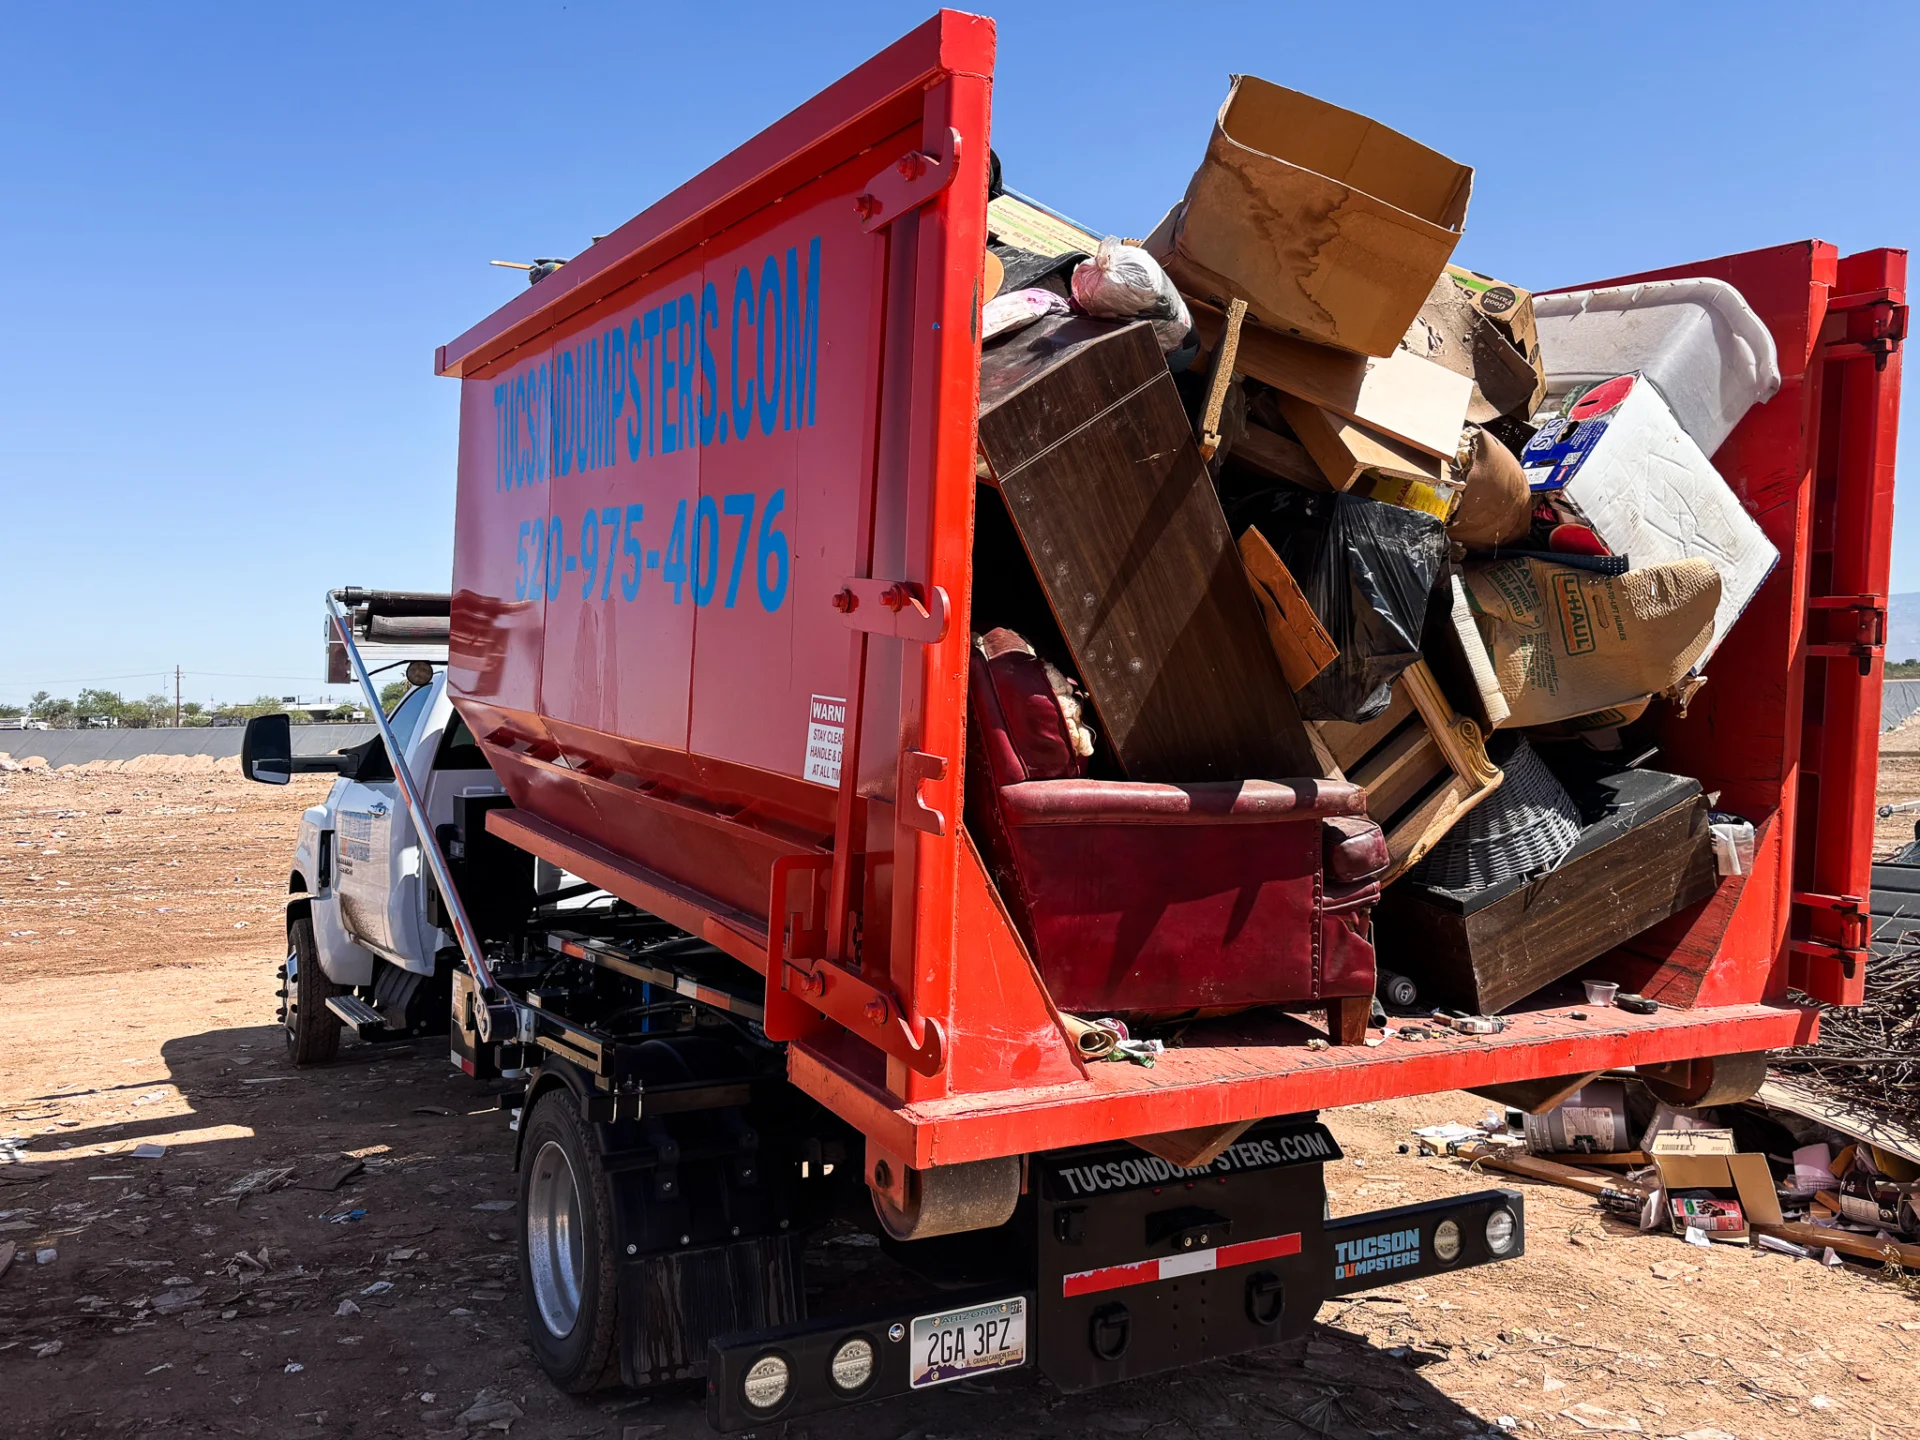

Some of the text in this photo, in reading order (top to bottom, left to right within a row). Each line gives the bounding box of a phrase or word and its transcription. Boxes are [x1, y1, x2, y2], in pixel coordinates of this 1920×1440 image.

[1483, 297, 1506, 310] Good
[1485, 291, 1514, 306] Farms
[494, 236, 822, 493] TUCSONDUMPSTERS.COM
[515, 488, 790, 613] 520-975-4076
[1487, 570, 1525, 617] GUARANTEED
[1497, 565, 1534, 613] BEST PRICE
[1563, 578, 1591, 650] U-HAUL
[1604, 577, 1628, 641] ASY-TO-LIFT HANDLES
[813, 702, 846, 723] WARNI
[813, 728, 827, 742] STAY
[810, 745, 832, 762] HANDLE
[832, 749, 837, 762] &
[812, 763, 820, 776] AT
[819, 764, 830, 779] ALL
[1058, 1132, 1332, 1194] TUCSONDUSTERS.COM
[1335, 1227, 1420, 1264] TUCSON
[1335, 1250, 1420, 1280] DUMPSTERS
[941, 1307, 998, 1325] ARIZONA
[927, 1317, 1011, 1367] 2GA 3PZ
[973, 1348, 1020, 1365] GRAND CANYON STATE
